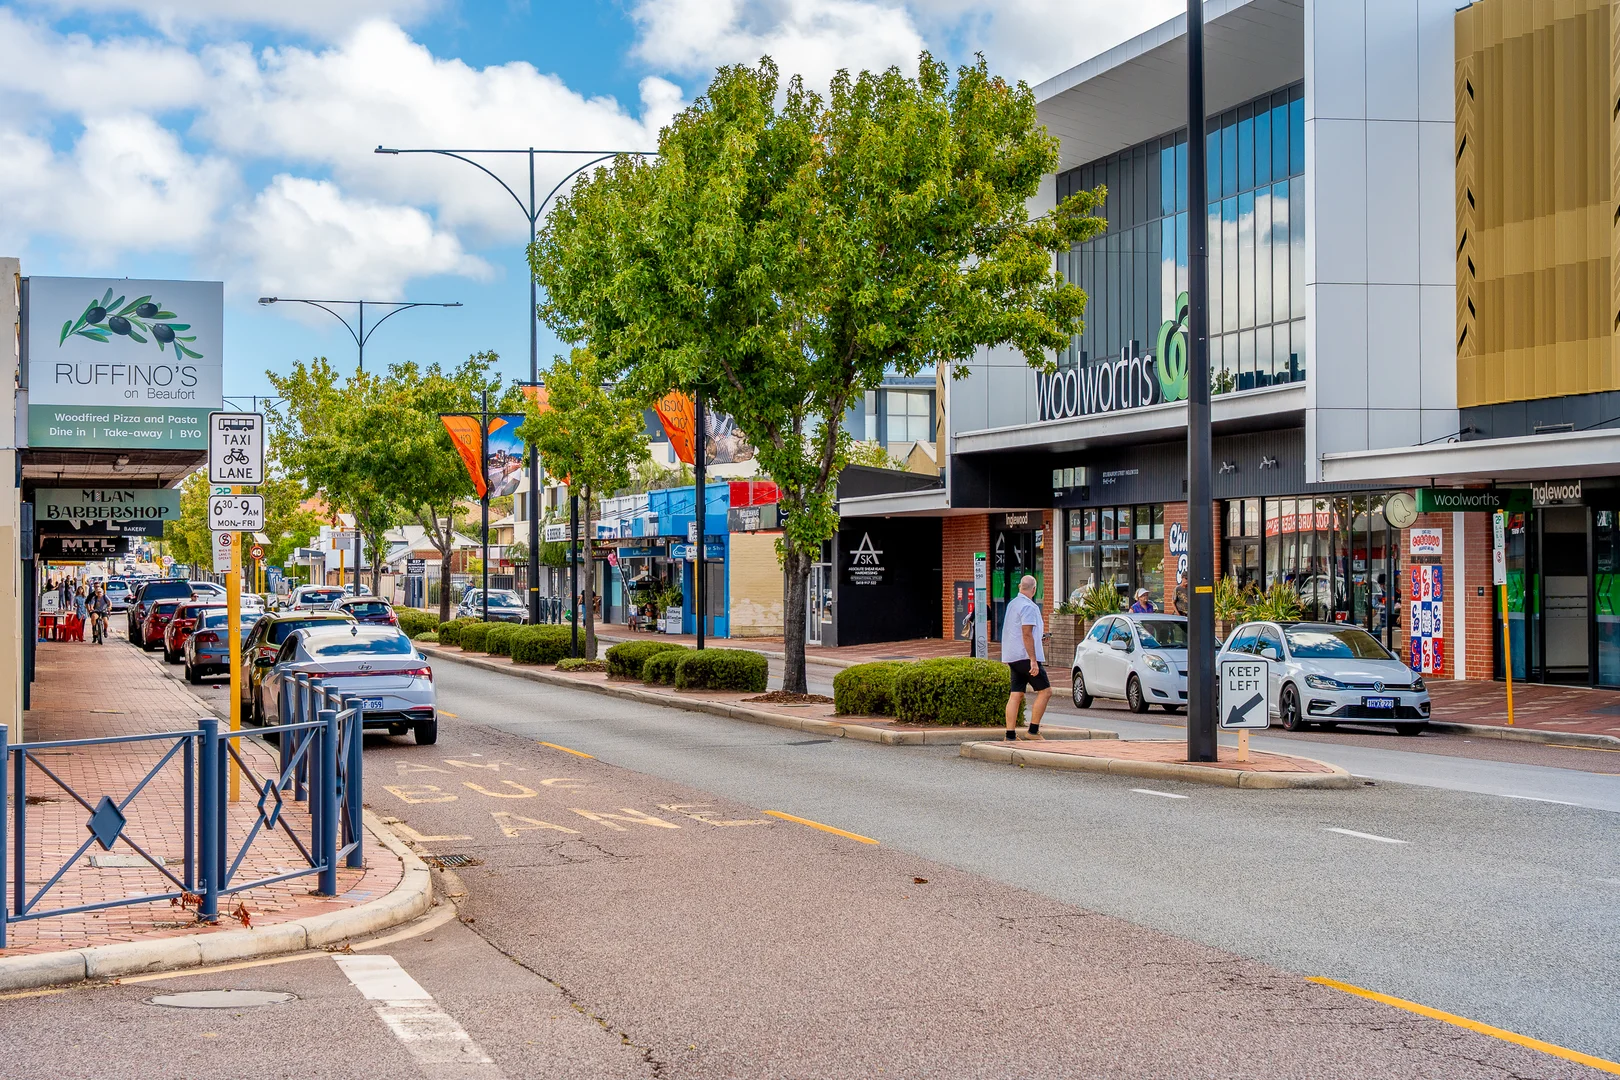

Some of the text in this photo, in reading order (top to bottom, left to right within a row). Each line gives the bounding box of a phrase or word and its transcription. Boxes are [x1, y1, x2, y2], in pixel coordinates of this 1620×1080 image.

[55, 363, 198, 387] RUFFINO'S
[124, 387, 196, 400] on Beaufort
[54, 412, 198, 424] Woodfired Pizza and Pasta
[49, 427, 202, 440] Dine in Take-away BYO
[222, 434, 251, 446] TAXI
[219, 468, 253, 479] LANE
[47, 504, 170, 519] BARBERSHOP
[1005, 511, 1029, 528] Inglewood
[62, 539, 116, 548] MTL
[1228, 666, 1261, 677] KEEP
[1229, 680, 1260, 691] LEFT
[381, 802, 775, 842] LANE
